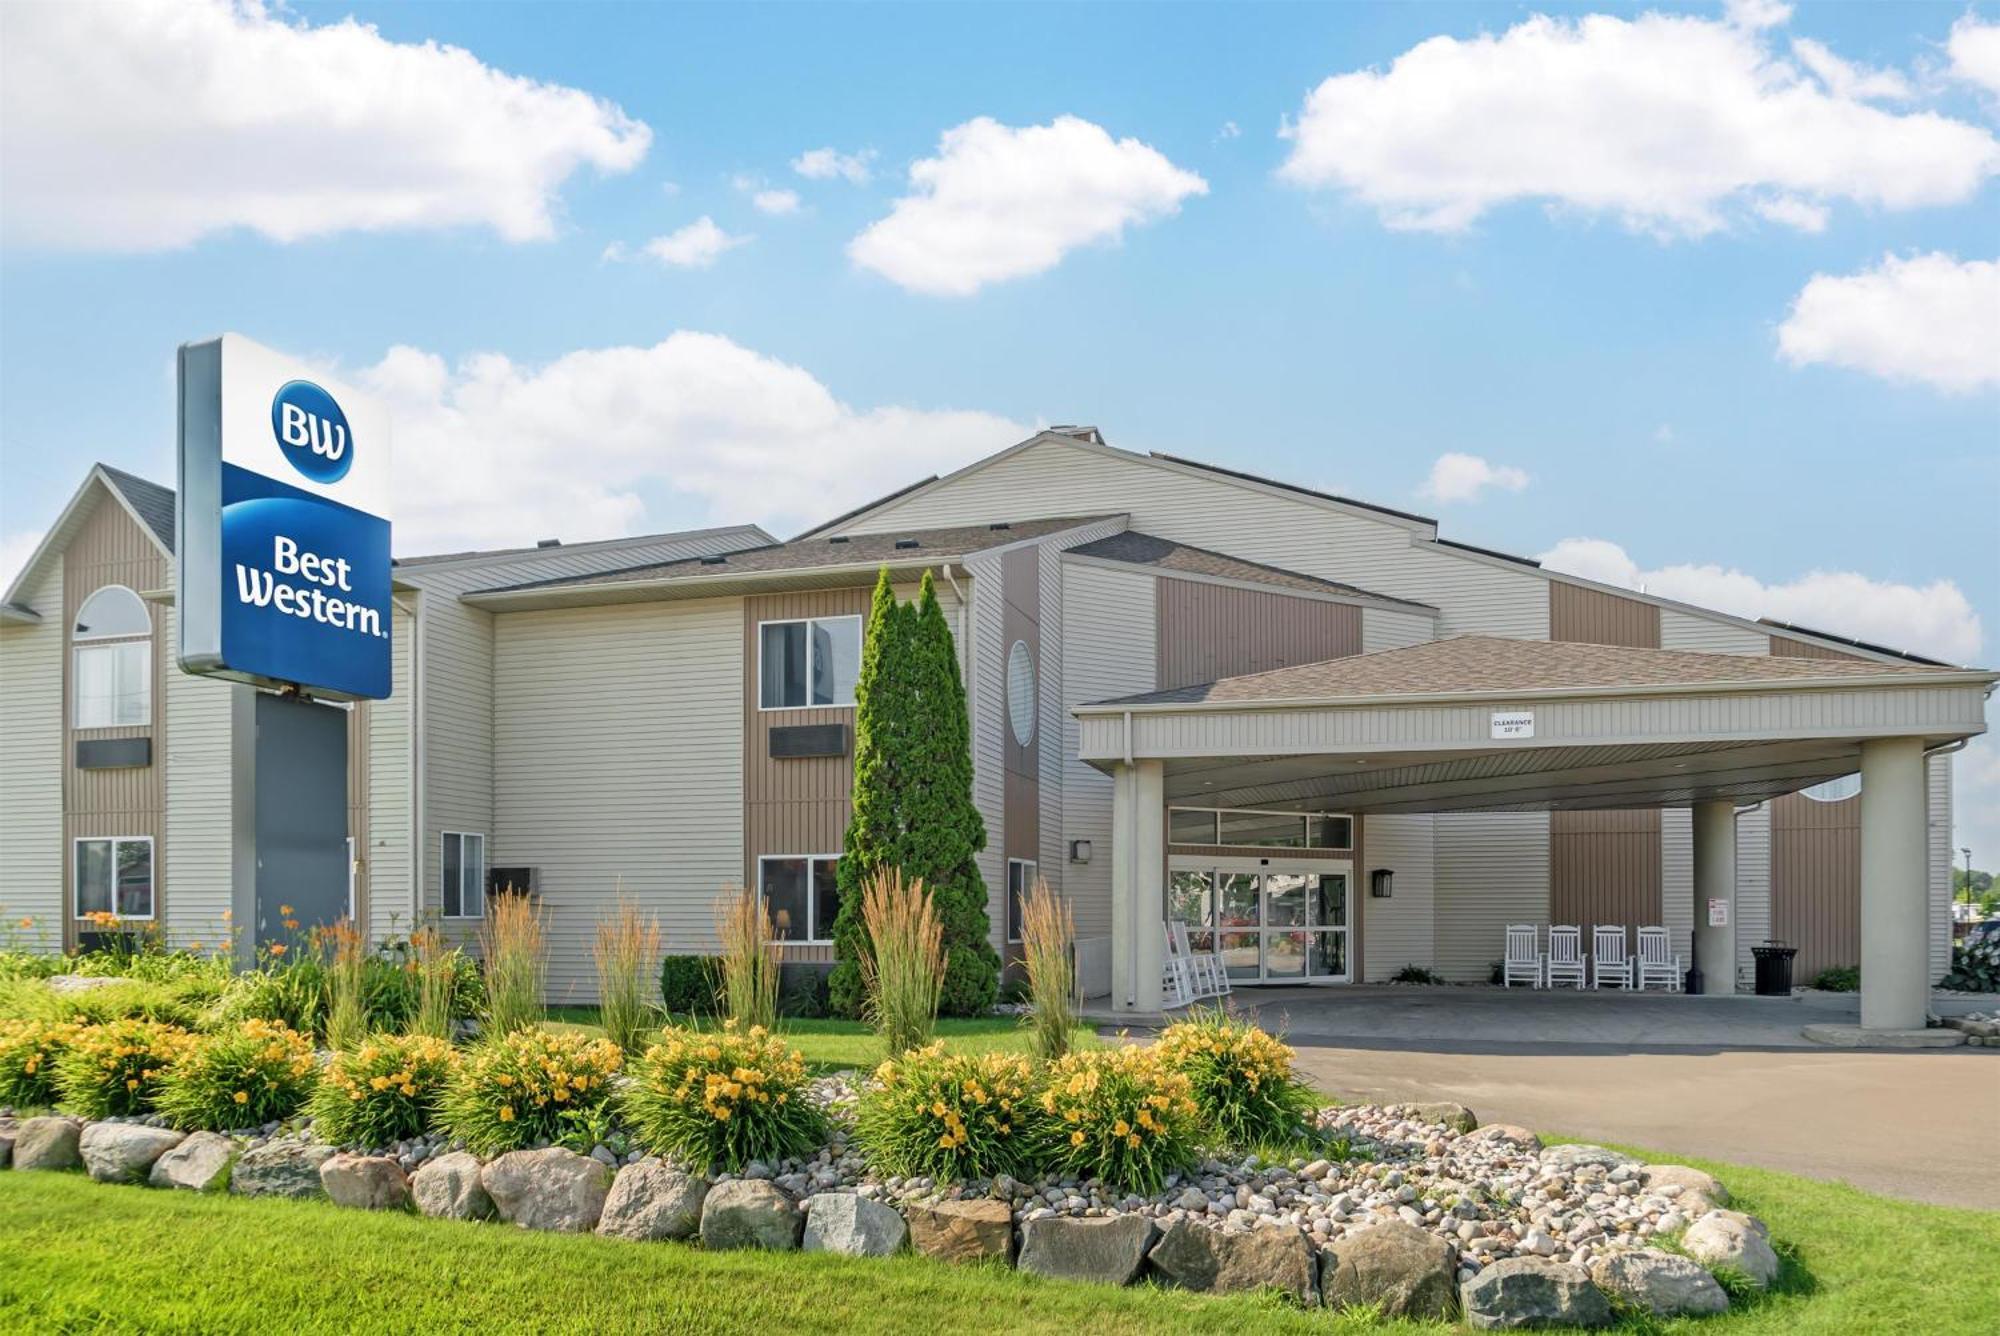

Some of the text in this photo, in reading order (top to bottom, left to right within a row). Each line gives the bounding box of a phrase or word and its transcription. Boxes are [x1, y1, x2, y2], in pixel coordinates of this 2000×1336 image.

[281, 401, 346, 462] BW
[274, 535, 352, 592] Best
[235, 563, 381, 637] Western
